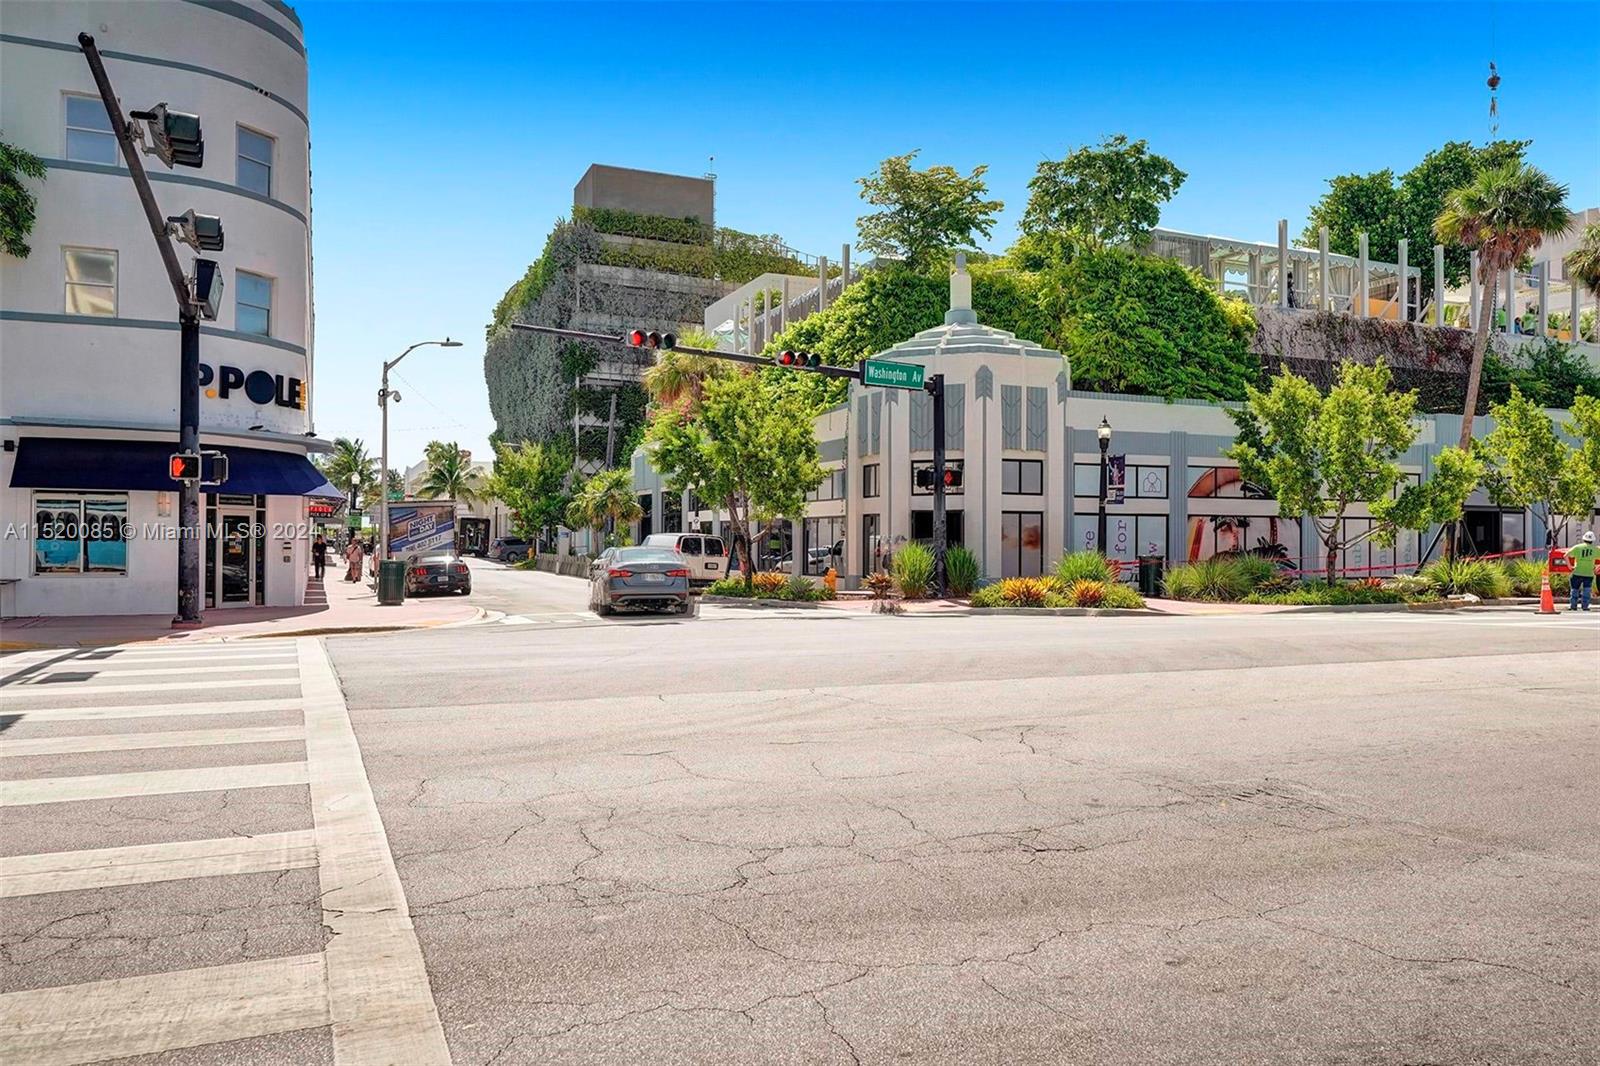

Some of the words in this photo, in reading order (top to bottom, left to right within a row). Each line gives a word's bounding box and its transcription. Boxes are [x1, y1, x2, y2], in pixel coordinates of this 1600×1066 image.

[868, 366, 907, 383] Washington
[912, 371, 922, 383] Av
[409, 515, 434, 528] NIGHT
[420, 522, 434, 533] DAY
[1115, 520, 1127, 554] for
